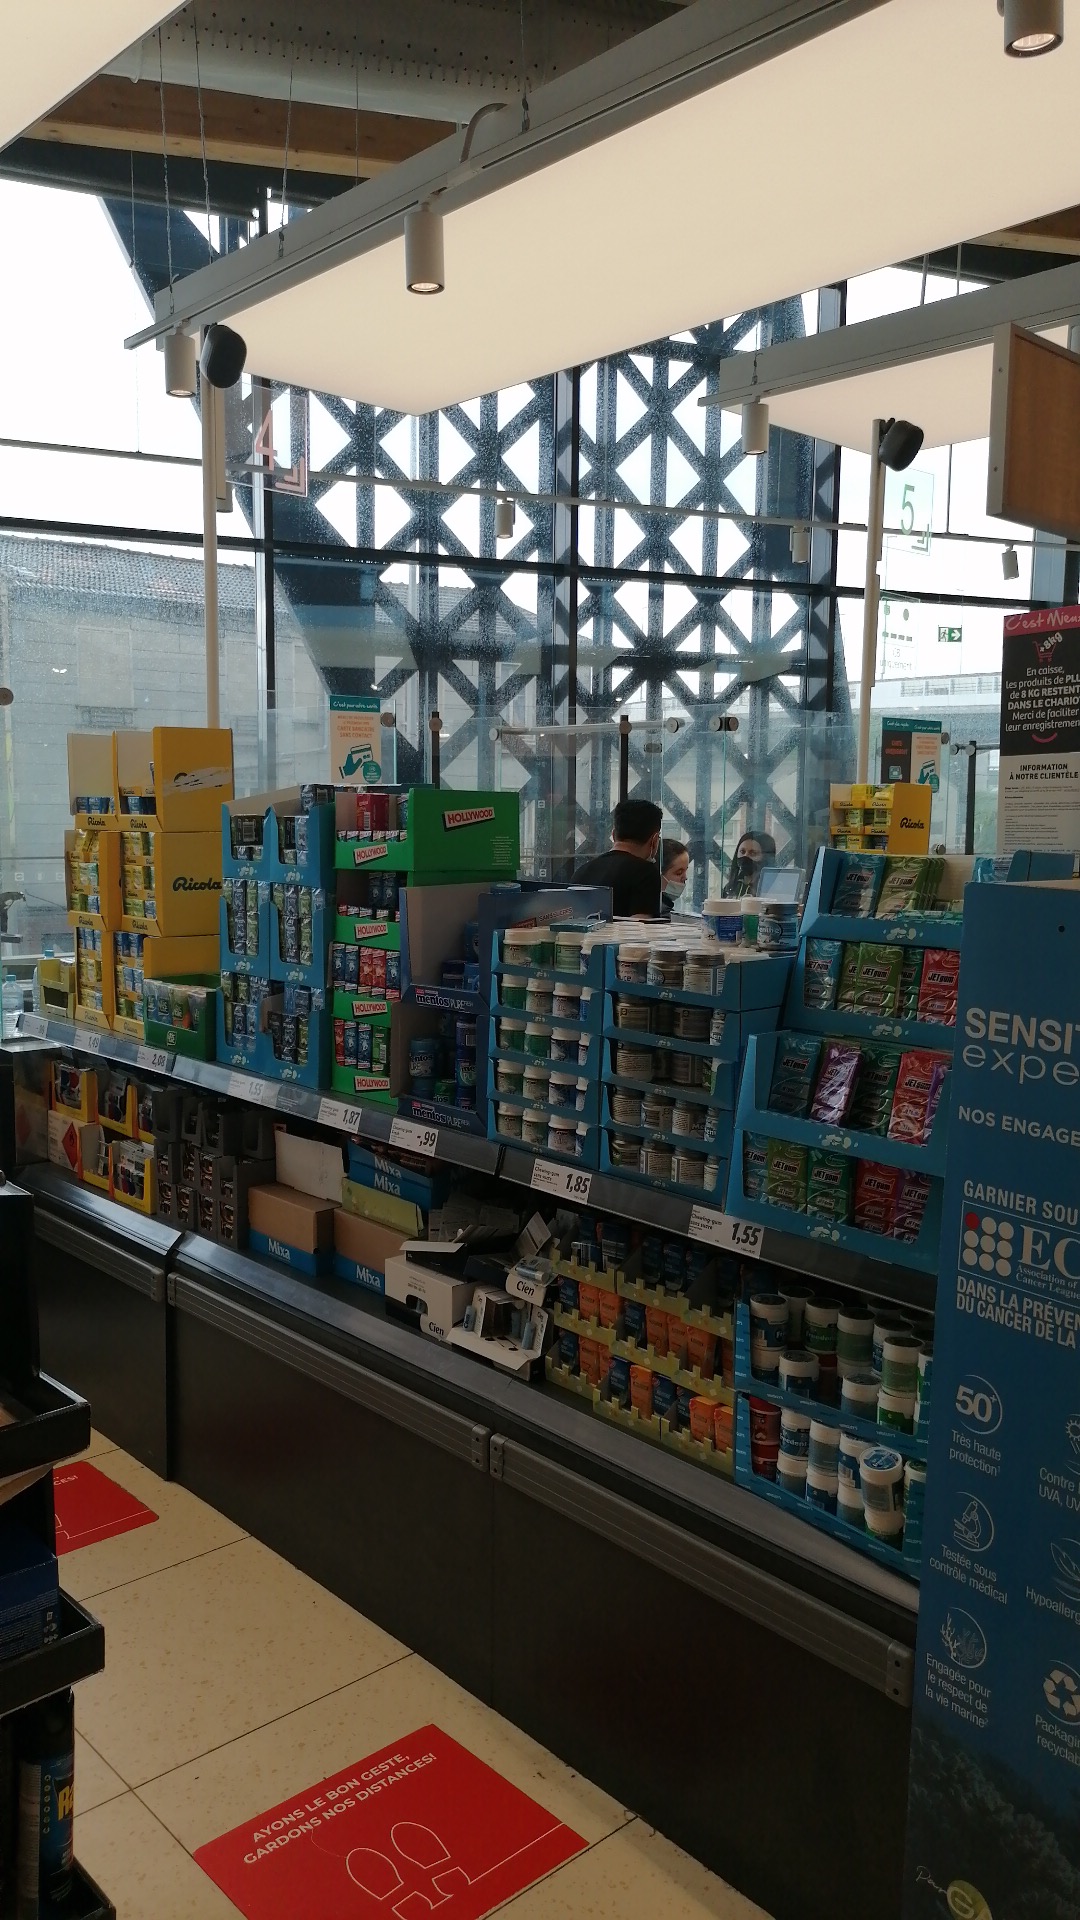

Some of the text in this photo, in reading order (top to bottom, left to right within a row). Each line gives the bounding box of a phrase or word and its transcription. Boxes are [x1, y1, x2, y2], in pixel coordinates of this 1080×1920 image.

[256, 409, 274, 471] 4
[901, 484, 915, 535] 5
[1006, 613, 1044, 630] C'est
[1026, 666, 1065, 676] En caisse,
[1006, 676, 1064, 690] les produits de
[1010, 691, 1019, 700] de
[1021, 690, 1026, 698] 8
[1028, 688, 1040, 698] KG
[1008, 700, 1031, 710] DANS
[1033, 699, 1043, 708] LE
[1012, 707, 1080, 721] Merci de faciliter
[1006, 723, 1020, 732] leur
[1009, 771, 1014, 780] À
[1016, 772, 1038, 780] NOTRE
[1020, 763, 1068, 772] INFORMATION
[88, 817, 106, 827] Ricola
[447, 809, 493, 825] HOLLYWOOD
[900, 817, 924, 829] Ricola
[356, 846, 387, 860] HOLLYWOOD
[172, 877, 222, 892] Ricola
[357, 924, 387, 936] HOLLYWOOD
[355, 1003, 386, 1013] HOLLYWOOD
[416, 994, 450, 1007] mentos
[88, 1036, 100, 1048] 1,49
[151, 1055, 166, 1067] 2,08
[962, 1044, 1080, 1086] expe
[356, 1078, 389, 1088] HOLLYWOOD
[343, 1109, 360, 1125] 1,87
[412, 1107, 446, 1123] mentos
[958, 1105, 1080, 1148] NOS ENGAGE
[417, 1131, 436, 1147] -,99
[375, 1157, 401, 1178] Mixa
[374, 1173, 400, 1195] Mixa
[566, 1173, 590, 1194] 1,85
[963, 1179, 1079, 1226] GARNIER SOU
[732, 1222, 762, 1247] 1,55
[268, 1238, 291, 1260] Mixa
[356, 1265, 381, 1288] Mixa
[1016, 1264, 1079, 1289] Association of
[1016, 1272, 1047, 1289] Cancer
[517, 1281, 535, 1297] Cien
[957, 1275, 997, 1304] DANS
[1000, 1289, 1019, 1312] LA
[428, 1321, 445, 1336] Cien
[956, 1293, 1077, 1350] DU CANCER DE LA
[951, 1429, 1001, 1461] Très haute
[1040, 1467, 1075, 1492] Contre
[1039, 1483, 1063, 1507] UVA,
[941, 1543, 997, 1583] Testée sous
[929, 1556, 1008, 1605] contrôle médical
[926, 1652, 992, 1698] Engagée pour
[925, 1684, 934, 1699] la
[936, 1692, 949, 1707] vie
[927, 1669, 988, 1714] le respect de
[252, 1753, 410, 1843] AYONS LE BON GESTE,
[243, 1752, 437, 1864] GARDONS NOS DISTANCES!
